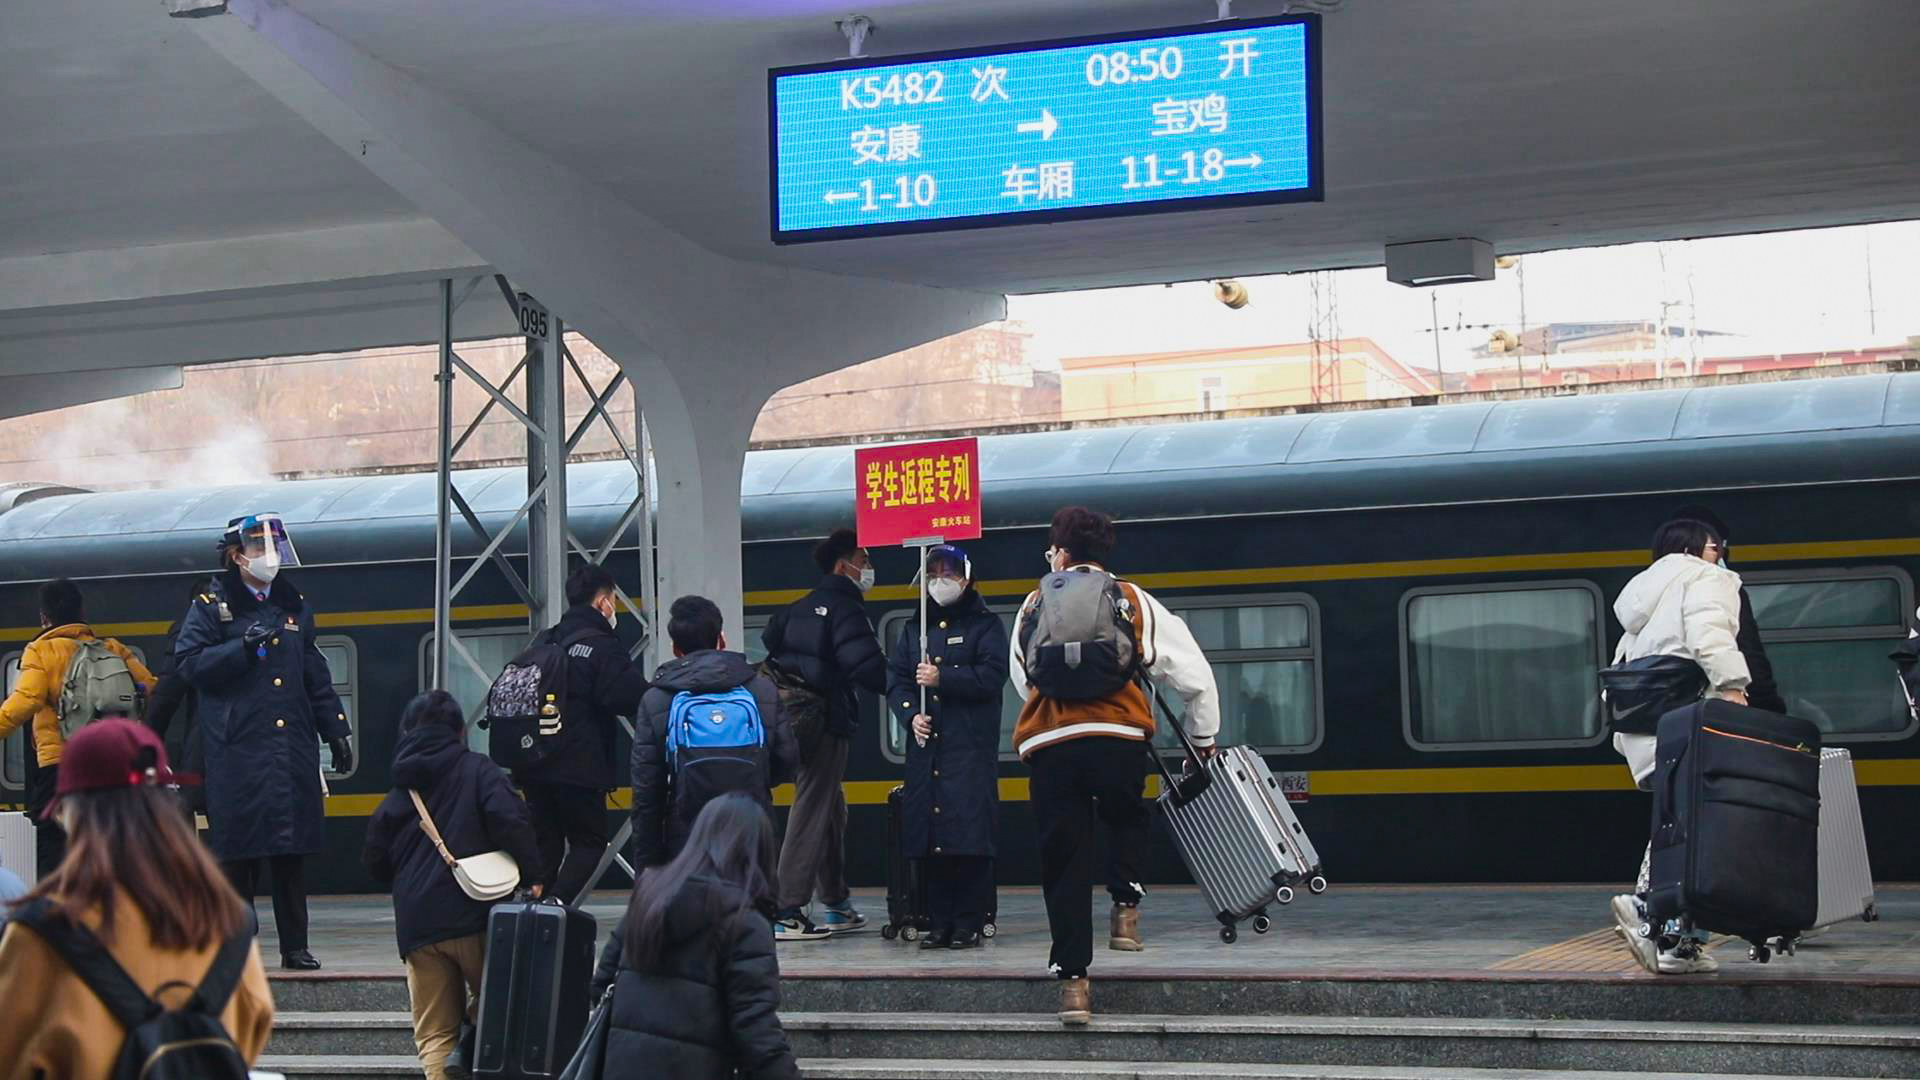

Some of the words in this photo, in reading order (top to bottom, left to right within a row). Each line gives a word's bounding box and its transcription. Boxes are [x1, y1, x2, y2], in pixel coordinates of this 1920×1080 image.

[841, 71, 945, 111] K5482
[969, 64, 1009, 102] 次
[1085, 47, 1183, 86] 08:50
[1218, 38, 1260, 80] 开
[850, 123, 922, 165] 安康
[1151, 93, 1229, 138] 宝鸡
[859, 174, 936, 212] 1-10
[1000, 161, 1074, 203] 车厢
[1120, 149, 1223, 190] 11-18
[521, 306, 547, 337] 095
[866, 453, 970, 509] 学生返程专列
